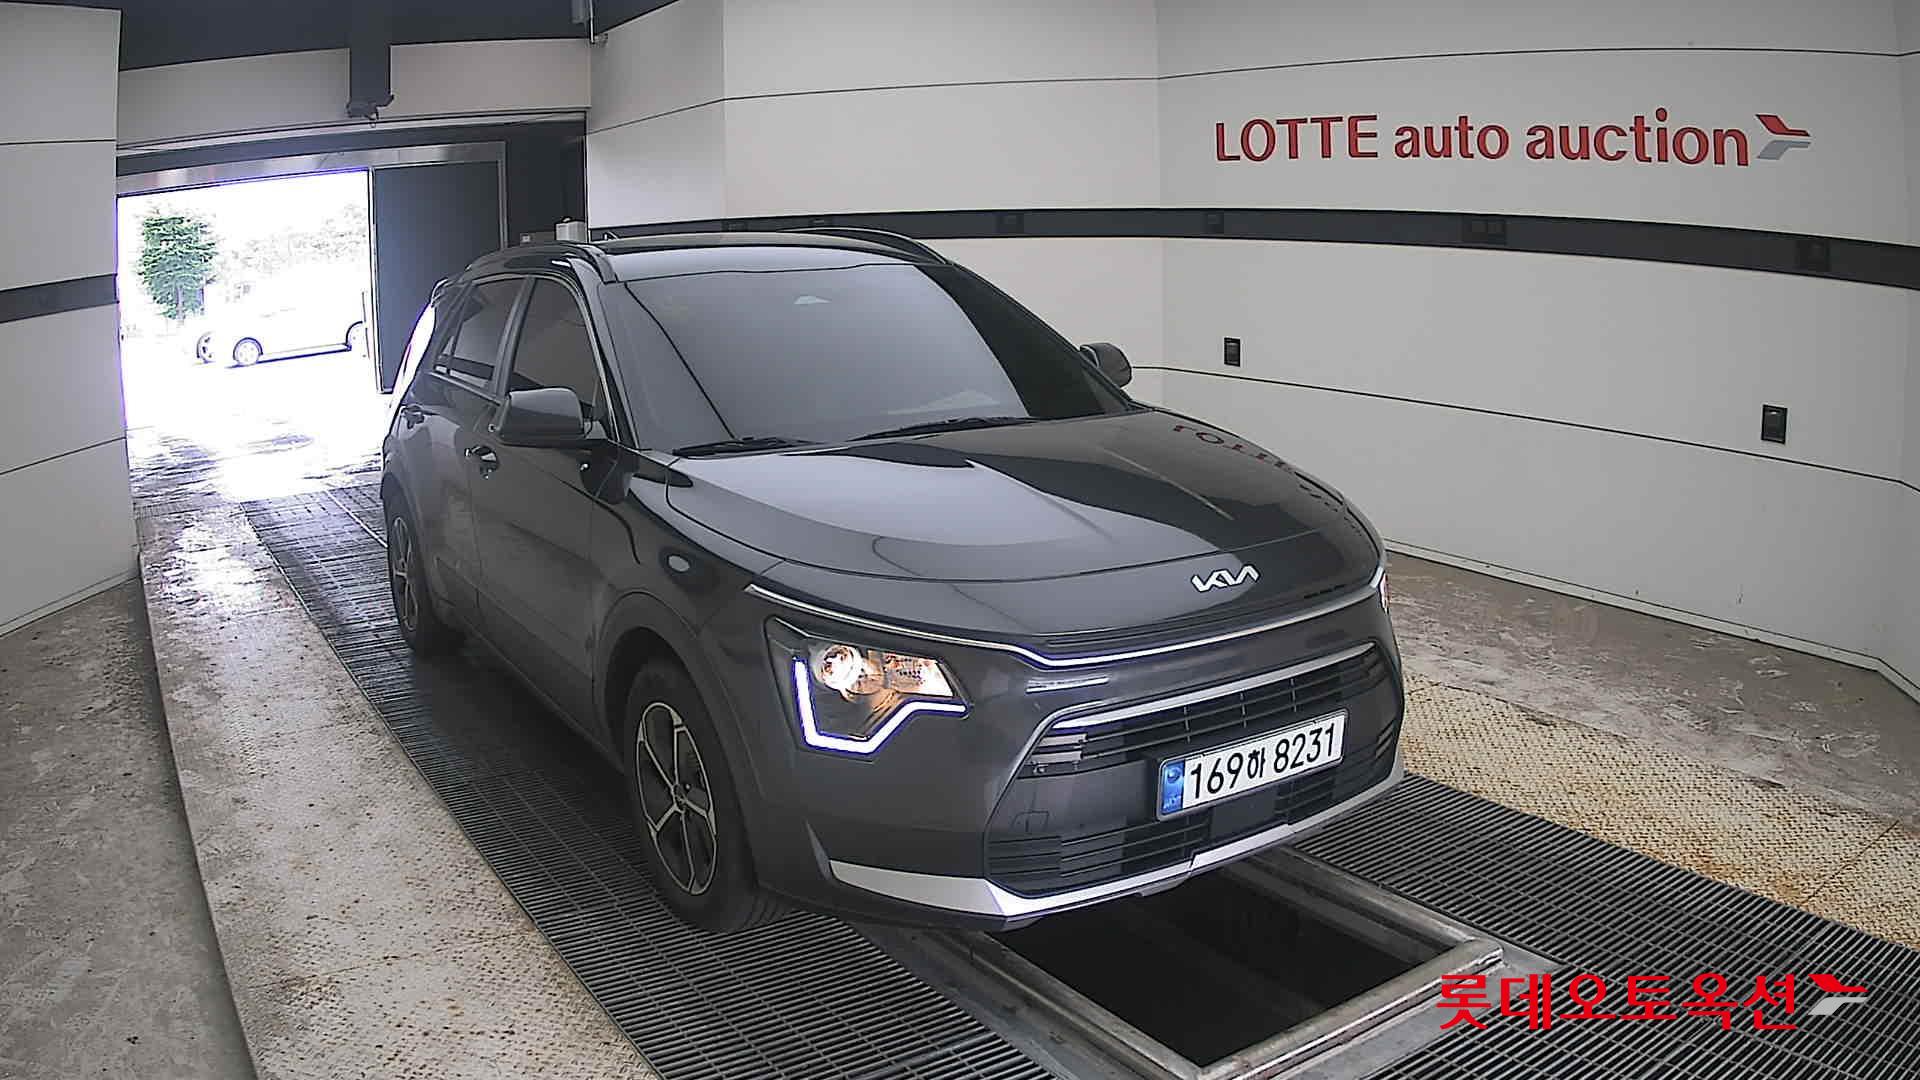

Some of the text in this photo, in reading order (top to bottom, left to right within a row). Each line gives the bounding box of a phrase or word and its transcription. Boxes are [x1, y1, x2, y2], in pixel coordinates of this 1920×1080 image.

[1215, 107, 1749, 166] LOTTE auto auction
[1190, 722, 1335, 799] 169하 8231
